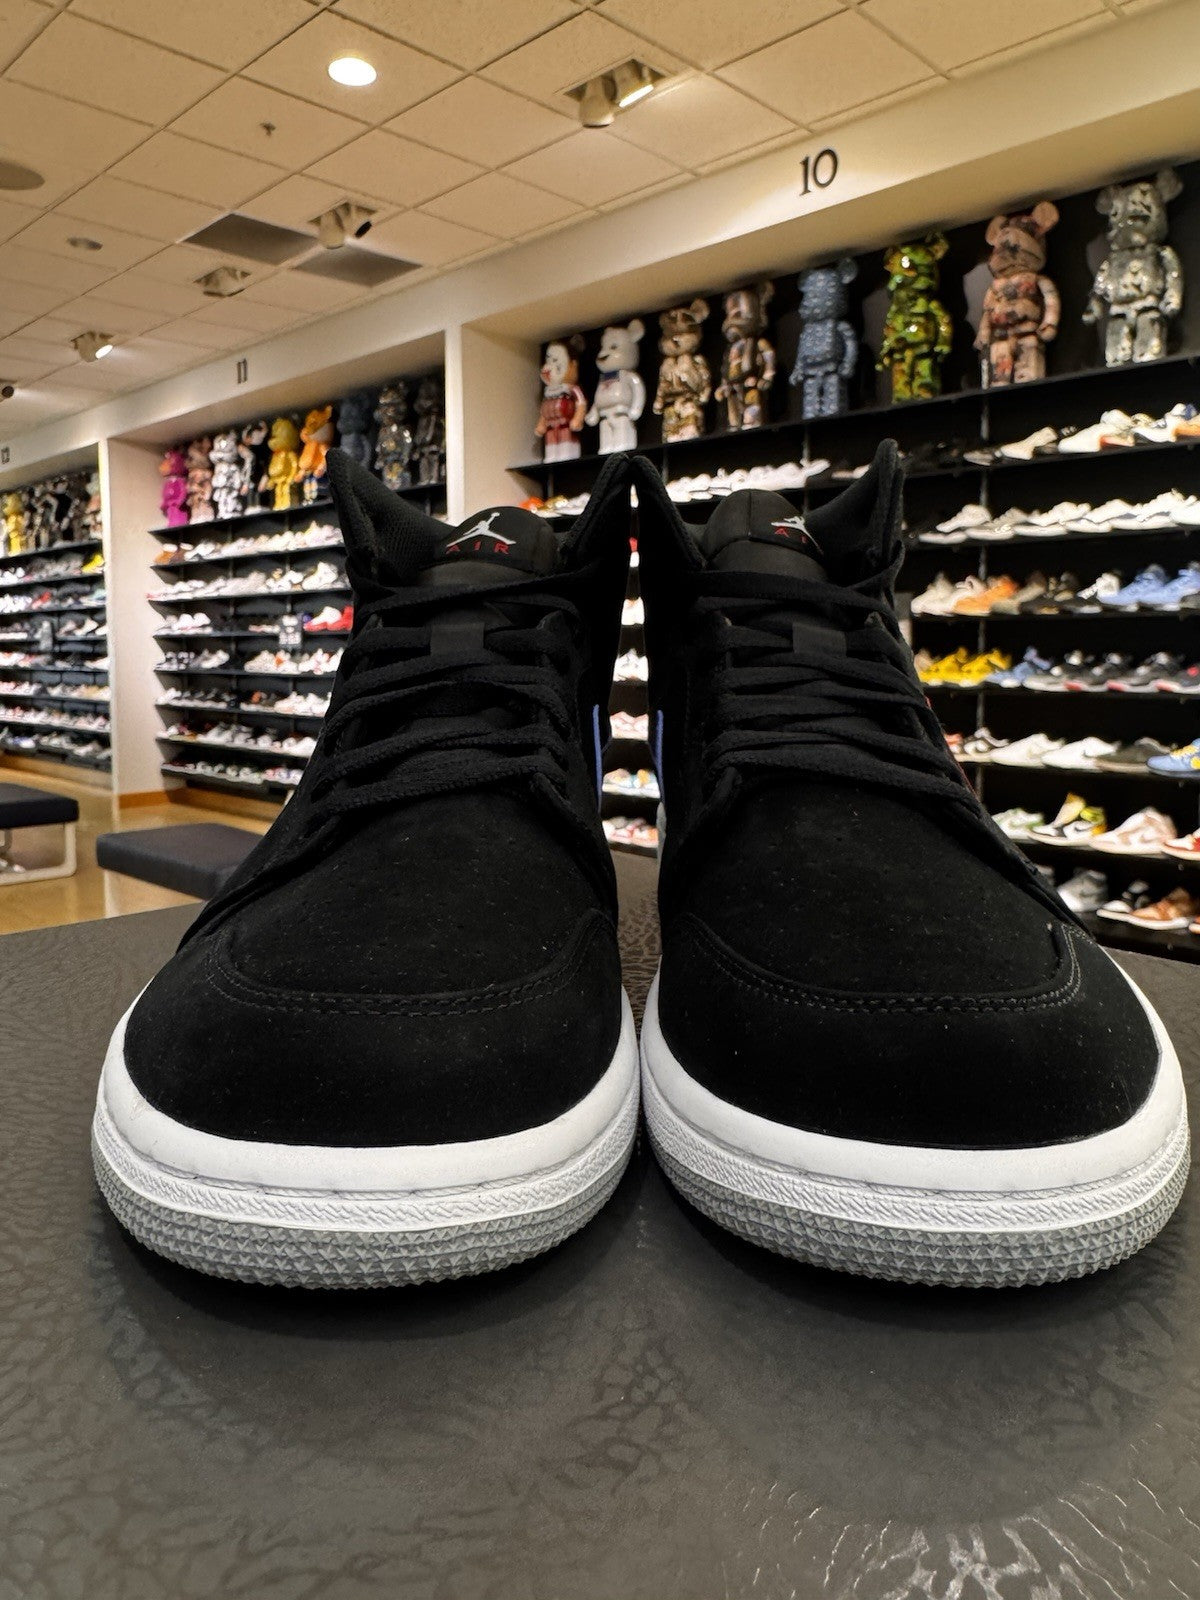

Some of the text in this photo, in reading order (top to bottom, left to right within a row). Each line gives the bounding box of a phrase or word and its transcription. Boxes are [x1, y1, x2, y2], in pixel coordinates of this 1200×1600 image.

[799, 149, 838, 196] 10
[236, 358, 248, 384] 11
[774, 526, 808, 544] AI
[445, 540, 510, 555] AIR
